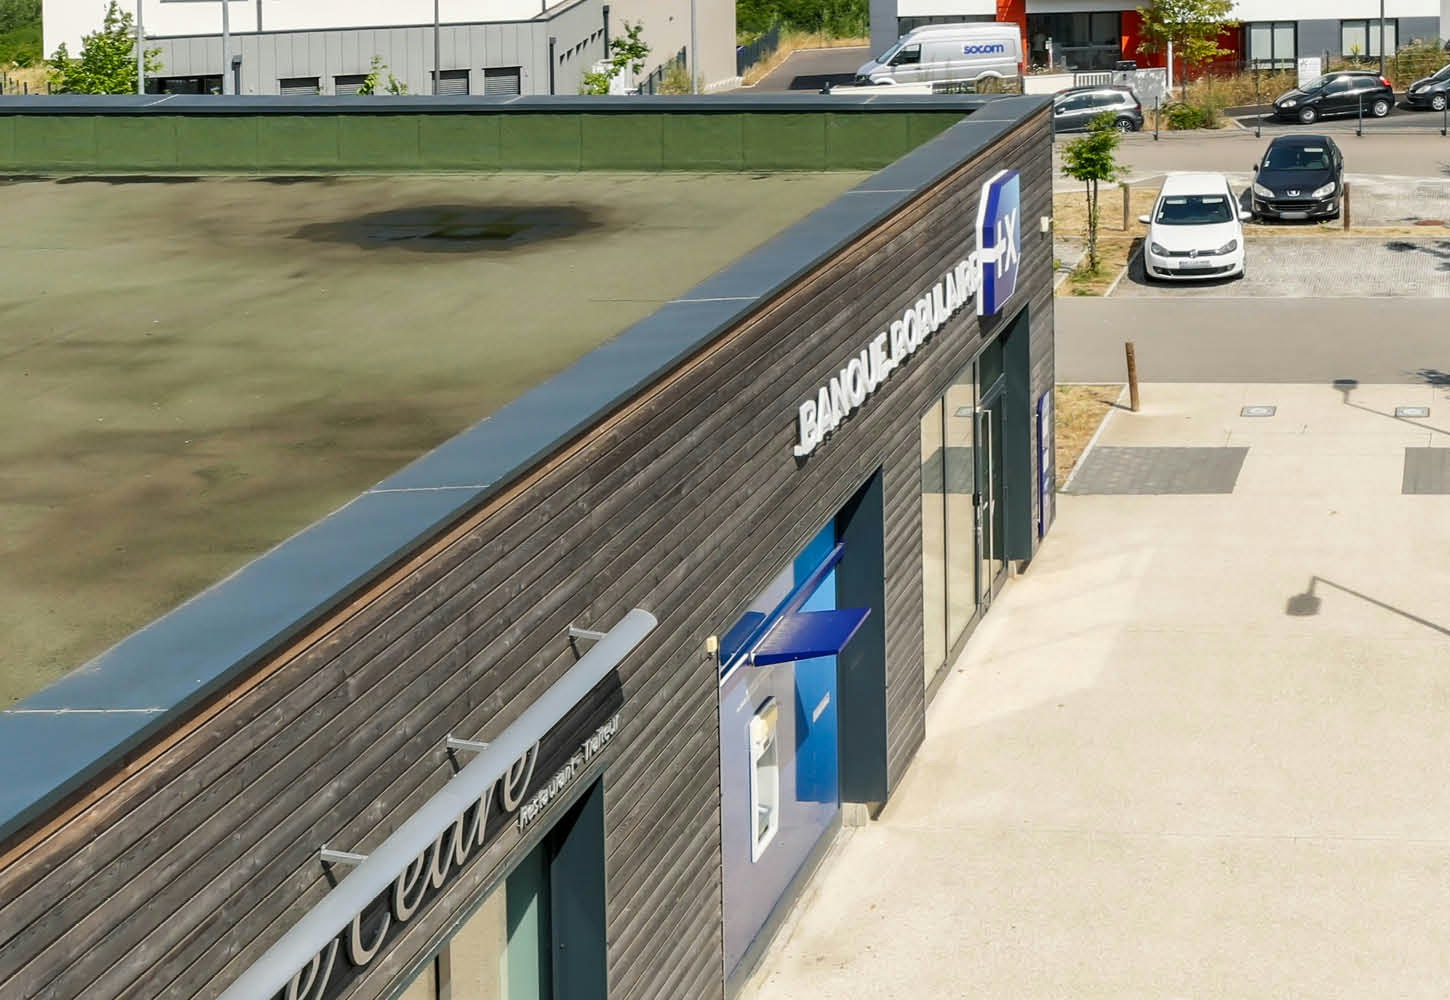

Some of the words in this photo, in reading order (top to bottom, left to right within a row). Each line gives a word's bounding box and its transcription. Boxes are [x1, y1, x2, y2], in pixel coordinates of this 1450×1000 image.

[794, 331, 893, 457] BANQUE
[518, 755, 578, 833] Restaurant
[581, 713, 620, 761] Traiteur
